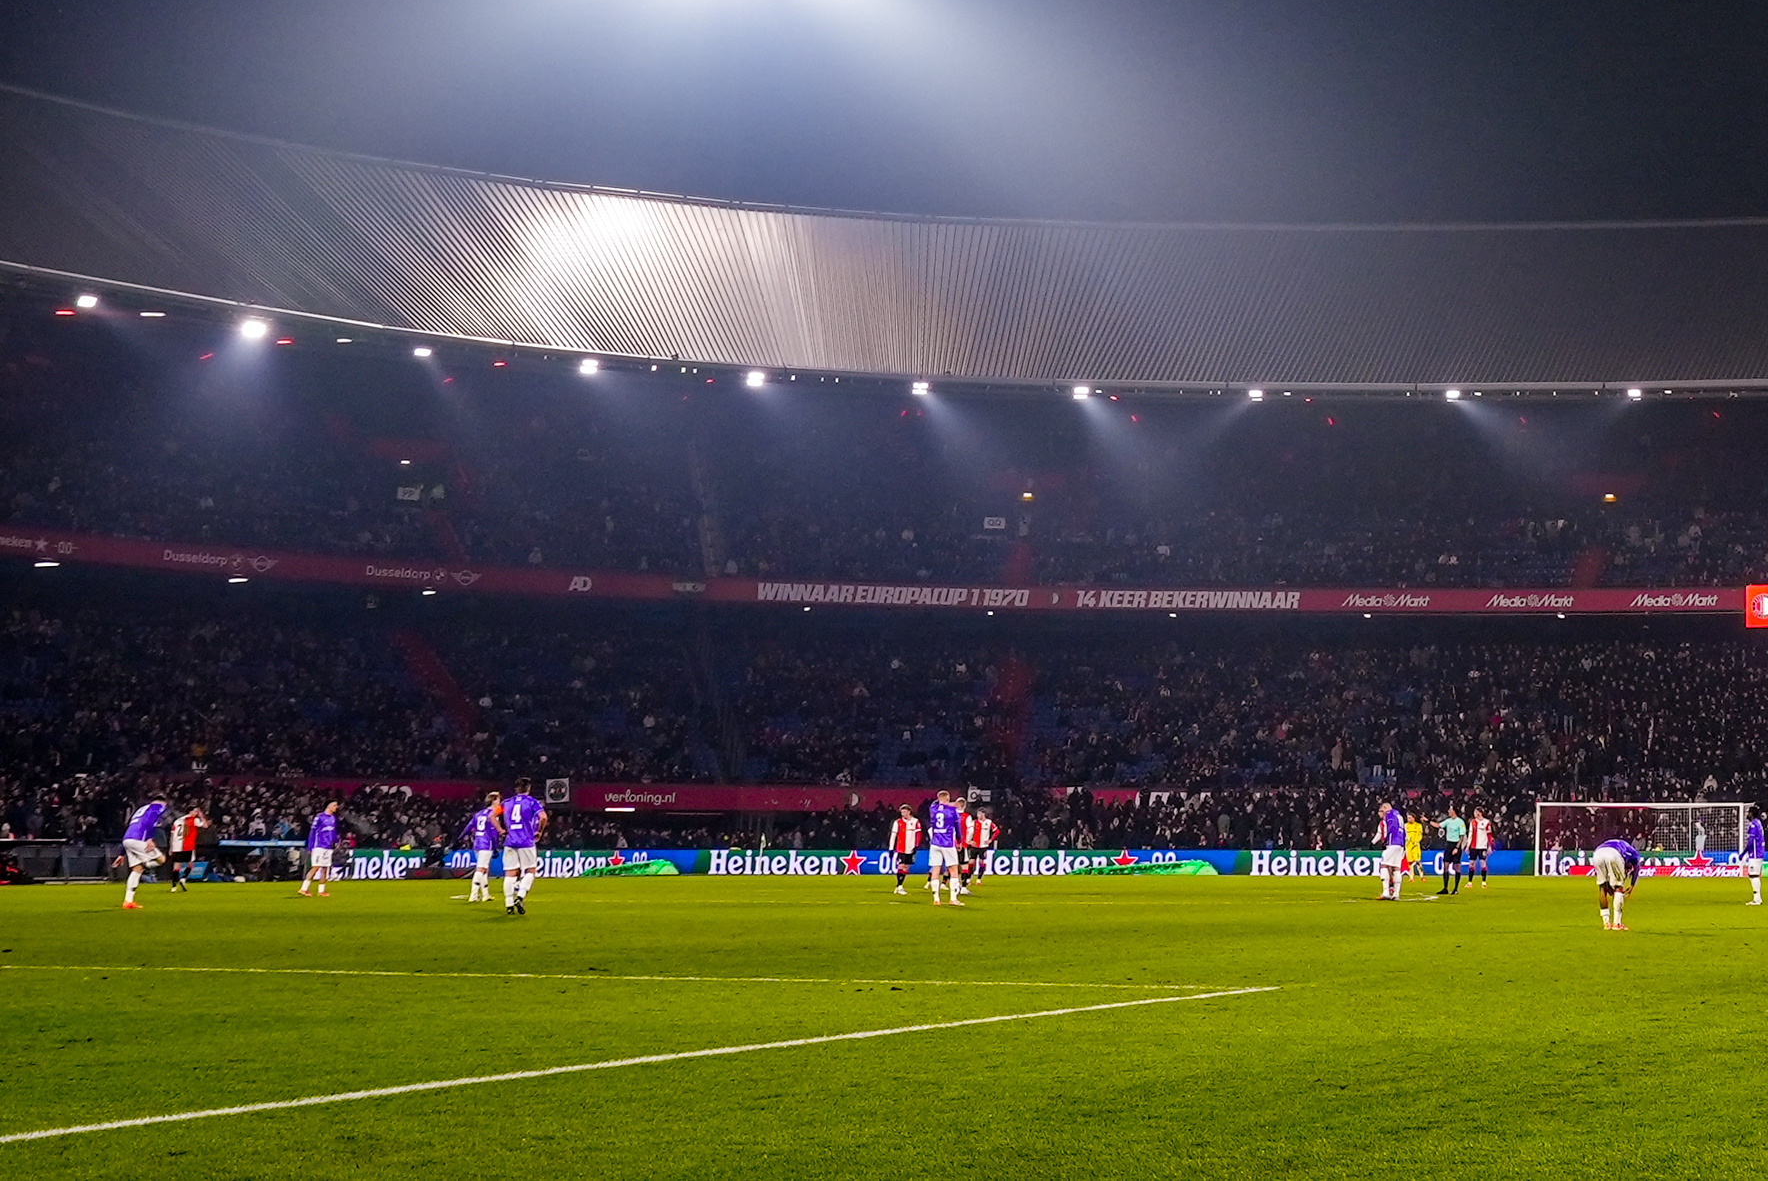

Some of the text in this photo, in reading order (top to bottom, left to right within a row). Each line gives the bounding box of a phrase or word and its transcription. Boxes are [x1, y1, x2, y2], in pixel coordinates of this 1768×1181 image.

[164, 549, 228, 567] Dusseldorp
[366, 565, 431, 580] Dusseldorp
[569, 576, 592, 592] AD
[757, 582, 855, 603] WINNAAR
[854, 585, 967, 606] EUROPACUP
[1076, 590, 1300, 609] 14 KEER BEKERWINNAAR
[604, 789, 676, 805] verloning.nl
[511, 804, 522, 823] 4
[935, 813, 944, 828] 3
[707, 850, 838, 875] Heineken
